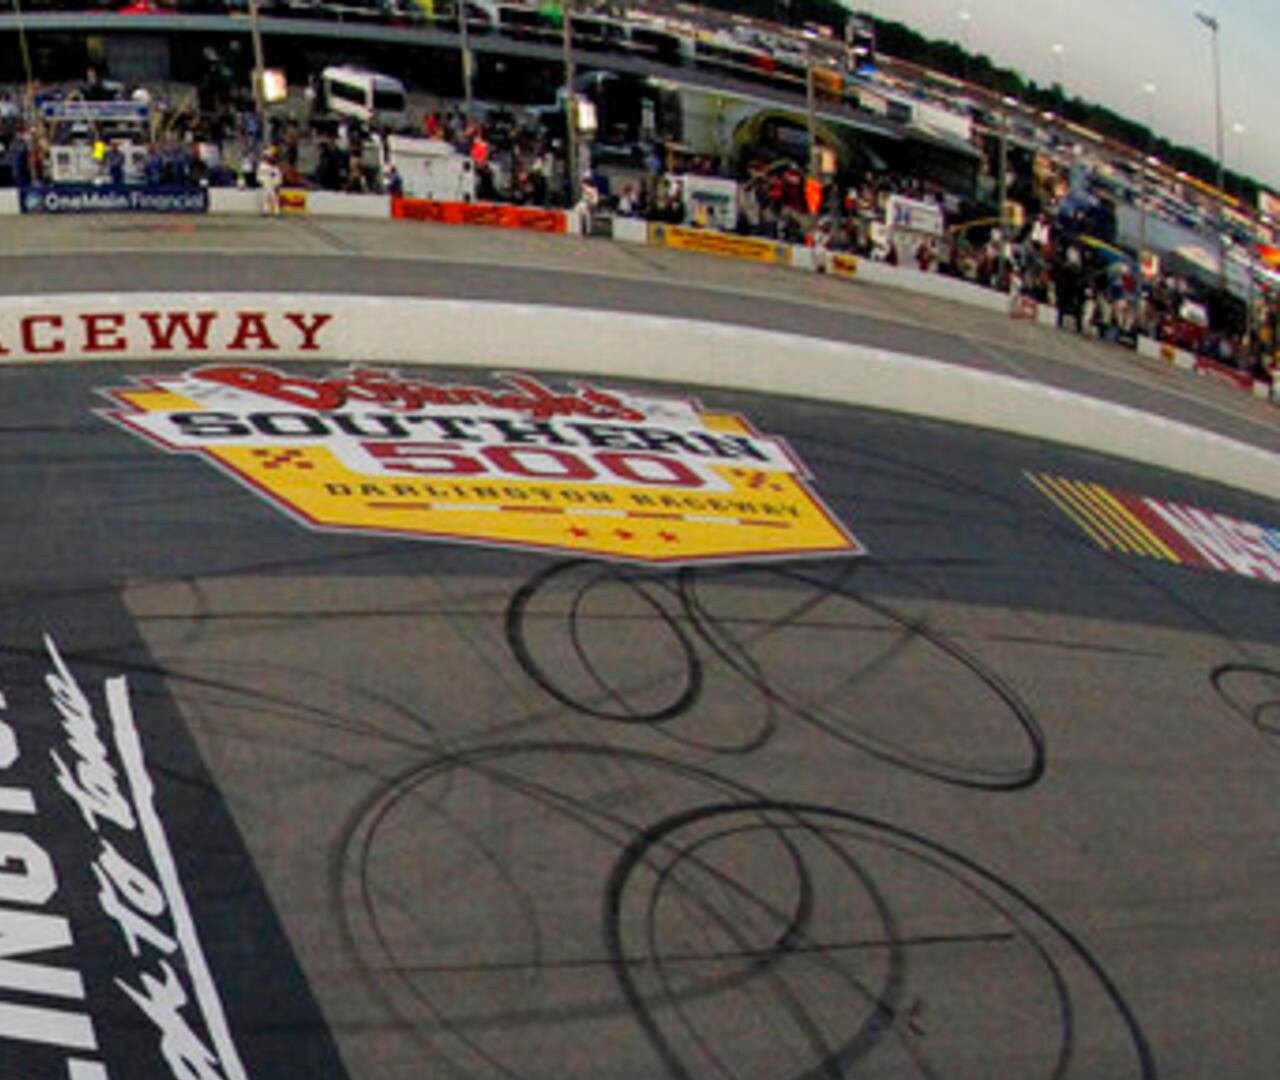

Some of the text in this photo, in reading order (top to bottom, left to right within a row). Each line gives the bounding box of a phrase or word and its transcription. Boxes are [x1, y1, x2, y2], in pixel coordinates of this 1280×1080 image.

[169, 411, 770, 463] SOUTHERN
[361, 442, 706, 488] 500
[325, 483, 801, 518] DARLINGTON RACEWAY
